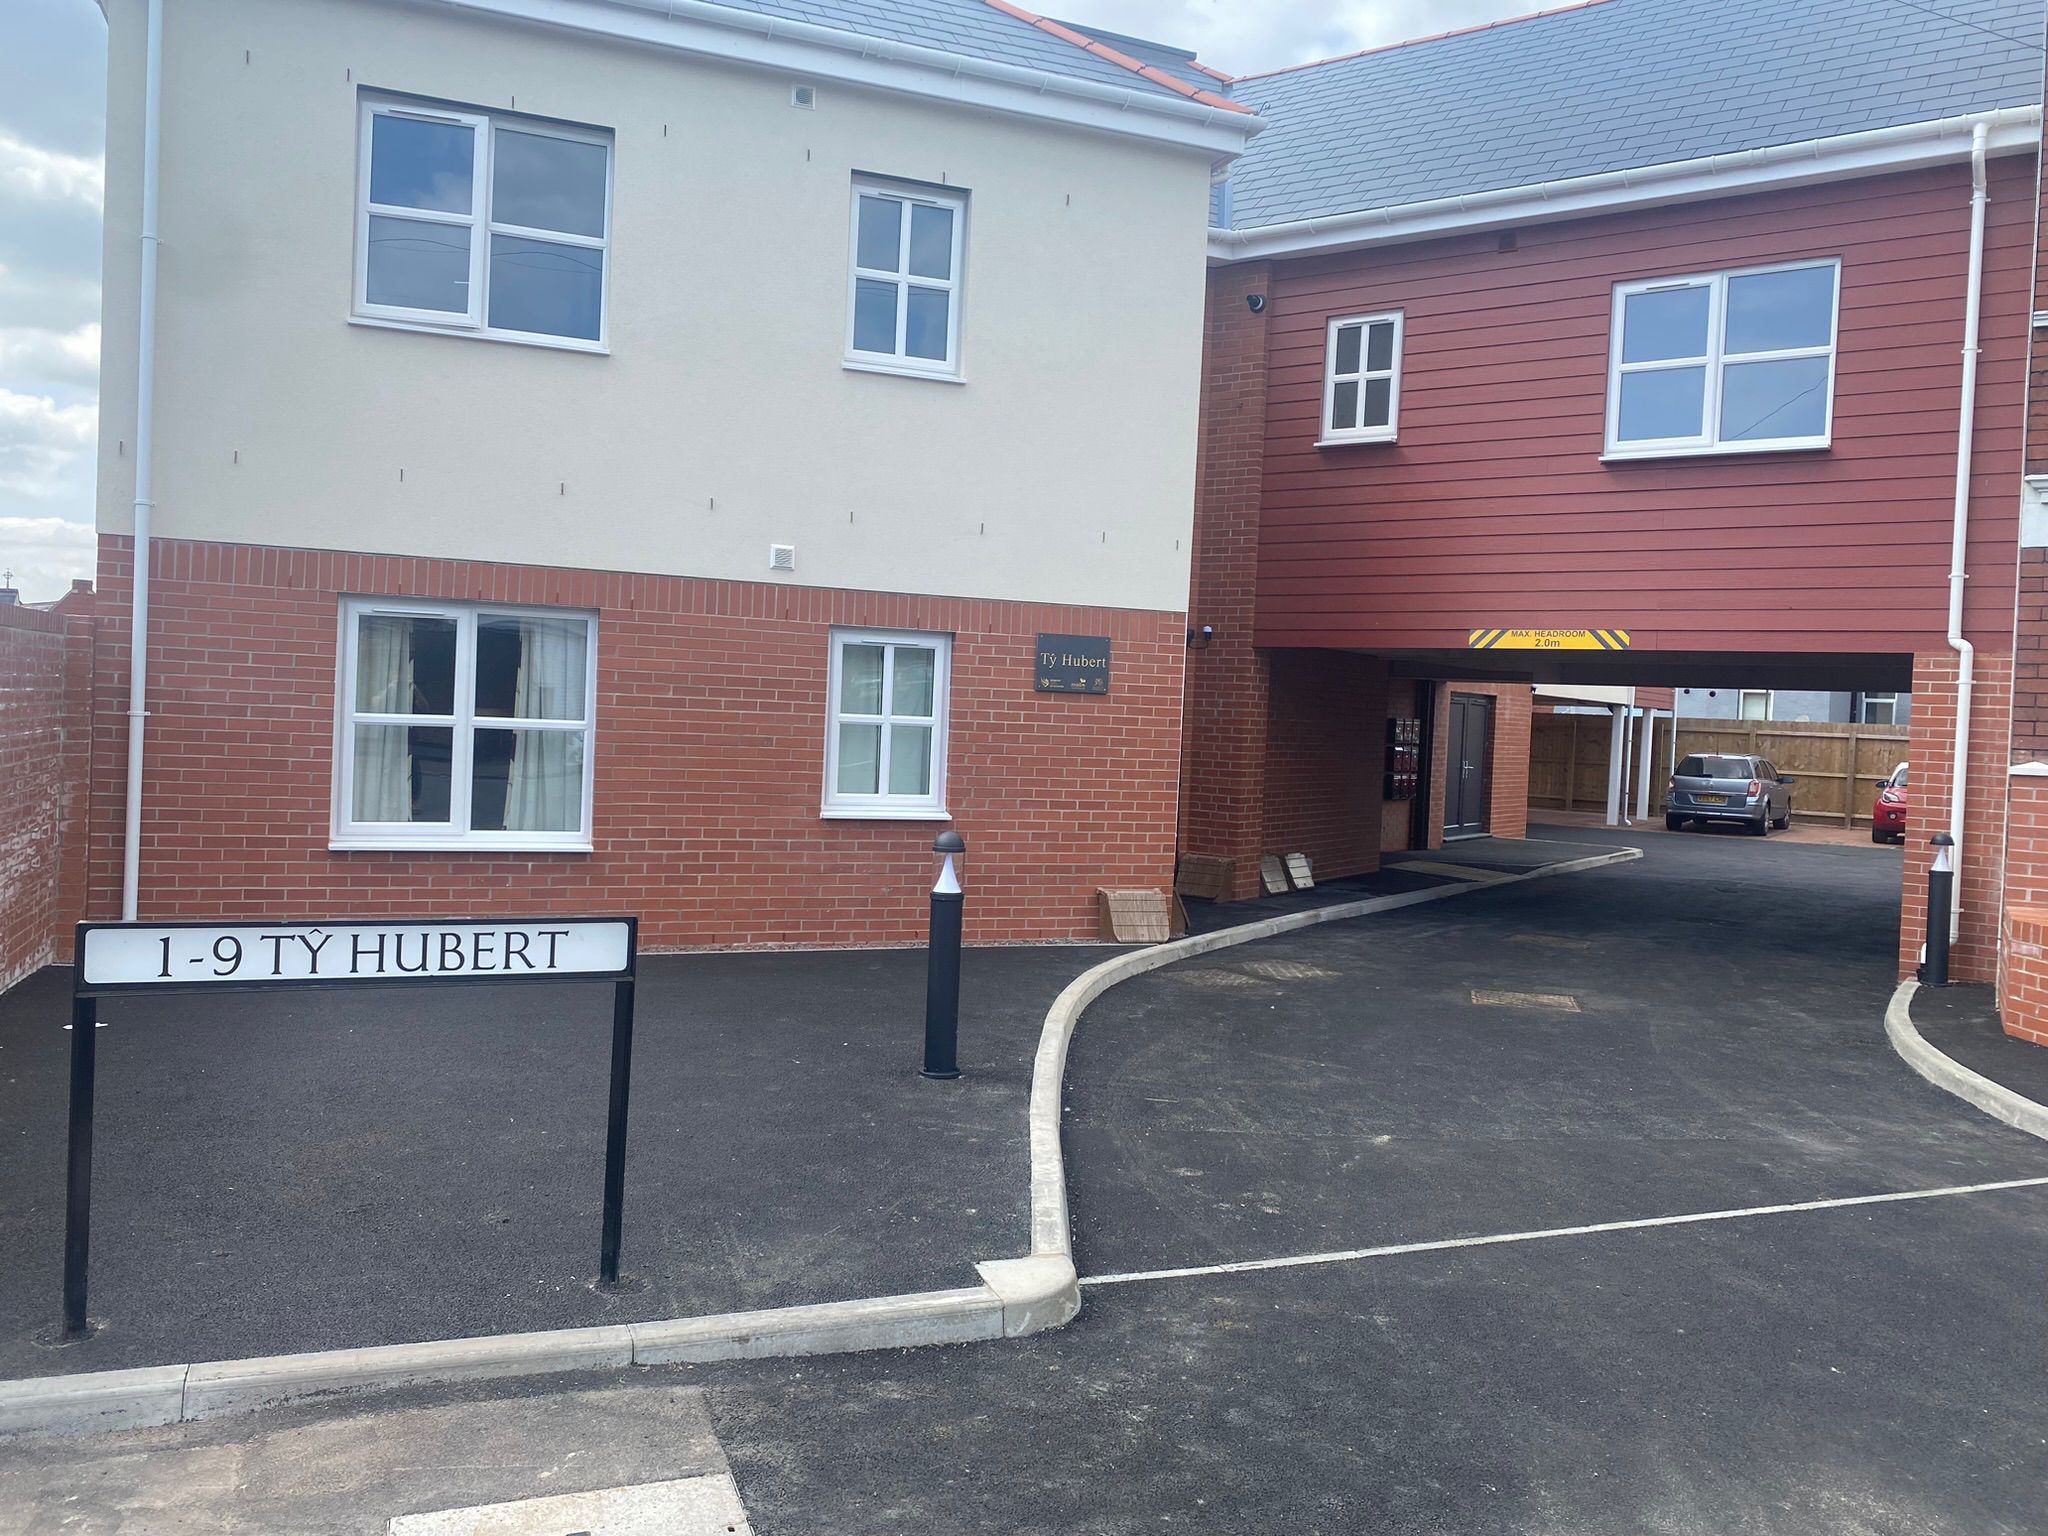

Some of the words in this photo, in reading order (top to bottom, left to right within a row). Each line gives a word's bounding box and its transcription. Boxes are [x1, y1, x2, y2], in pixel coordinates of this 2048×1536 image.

[1534, 630, 1586, 638] HEADROOM
[1535, 638, 1560, 647] 2.0m
[1062, 653, 1106, 668] Hubert
[157, 936, 243, 978] 1-9
[260, 928, 332, 976] TŶ
[350, 930, 570, 973] HUBERT
